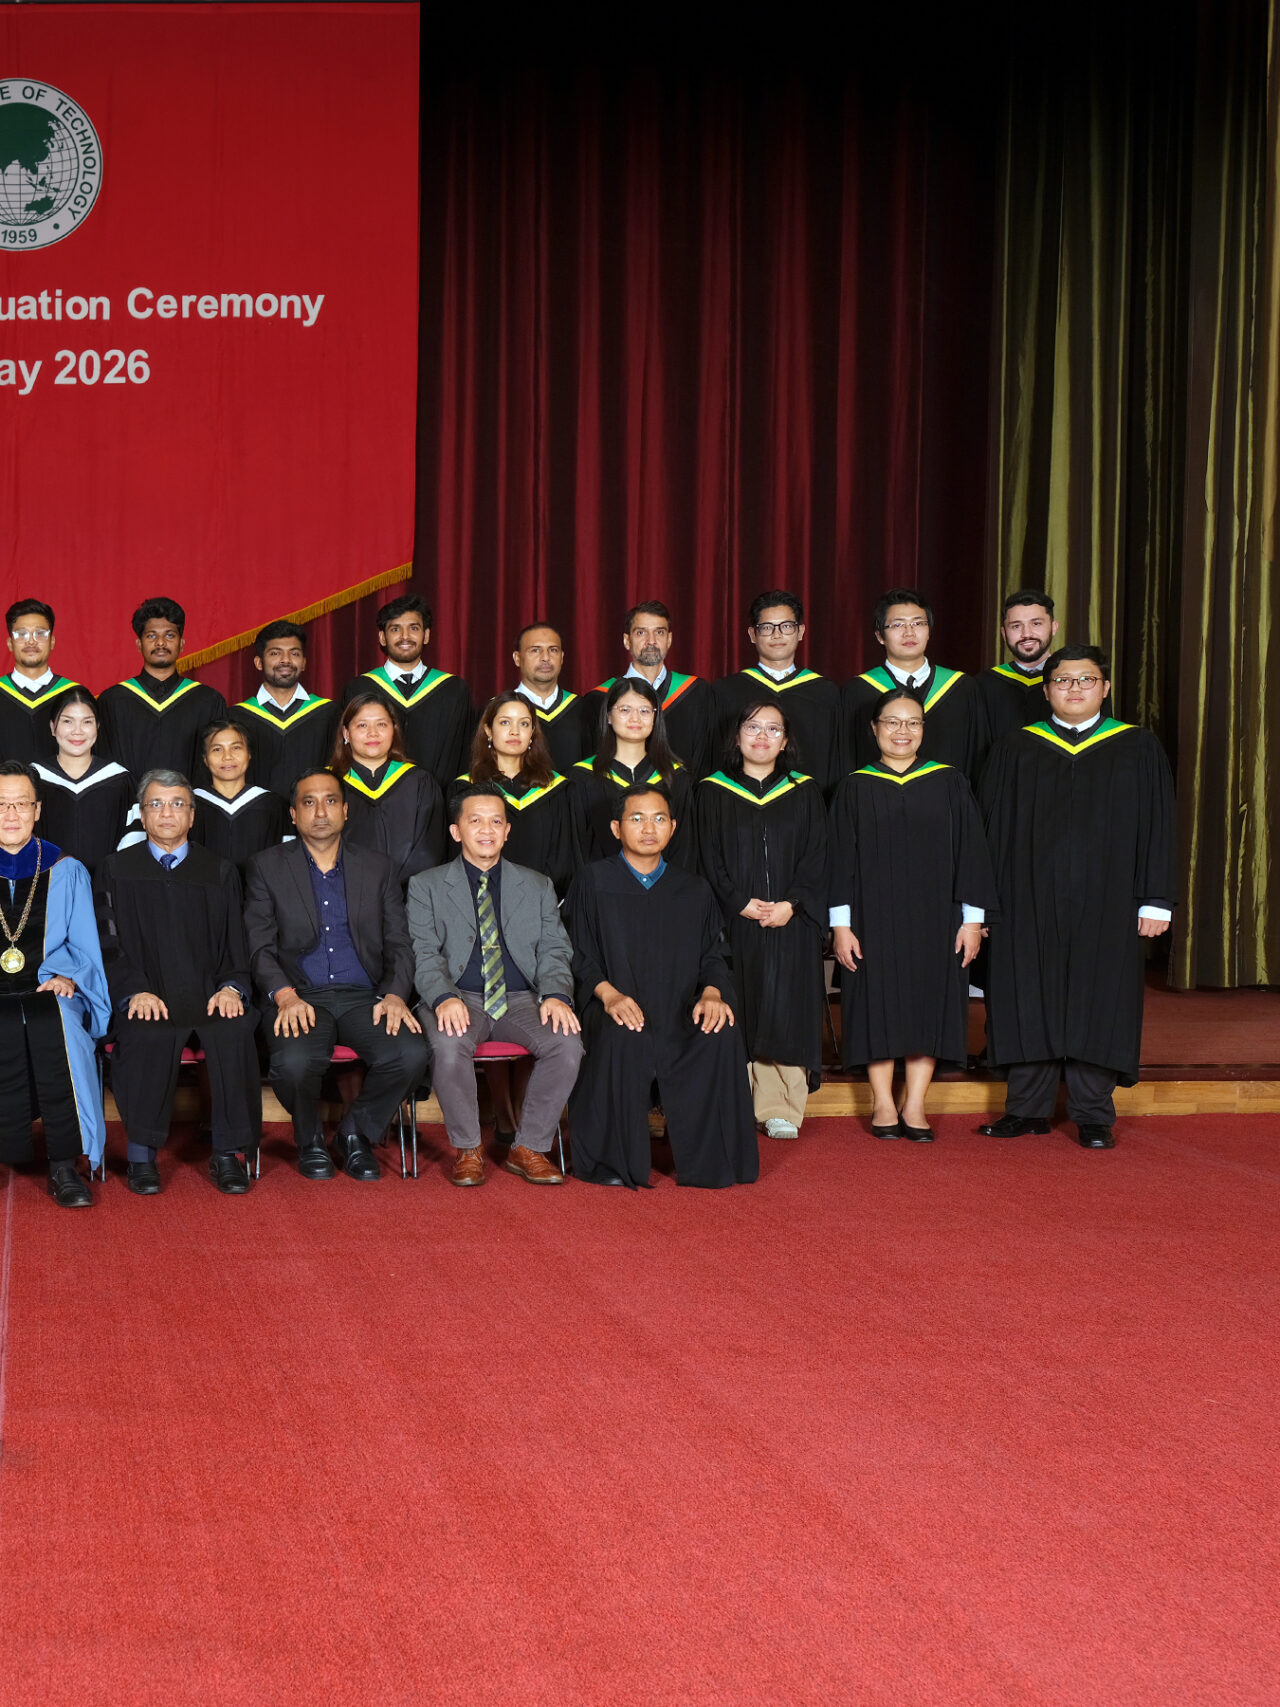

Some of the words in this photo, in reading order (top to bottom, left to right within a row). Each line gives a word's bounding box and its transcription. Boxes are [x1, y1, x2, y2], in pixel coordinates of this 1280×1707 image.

[22, 85, 48, 102] OF
[55, 98, 97, 221] TECHNOLOGY
[0, 228, 38, 244] 1959
[127, 286, 326, 328] Ceremony
[54, 349, 151, 386] 2026
